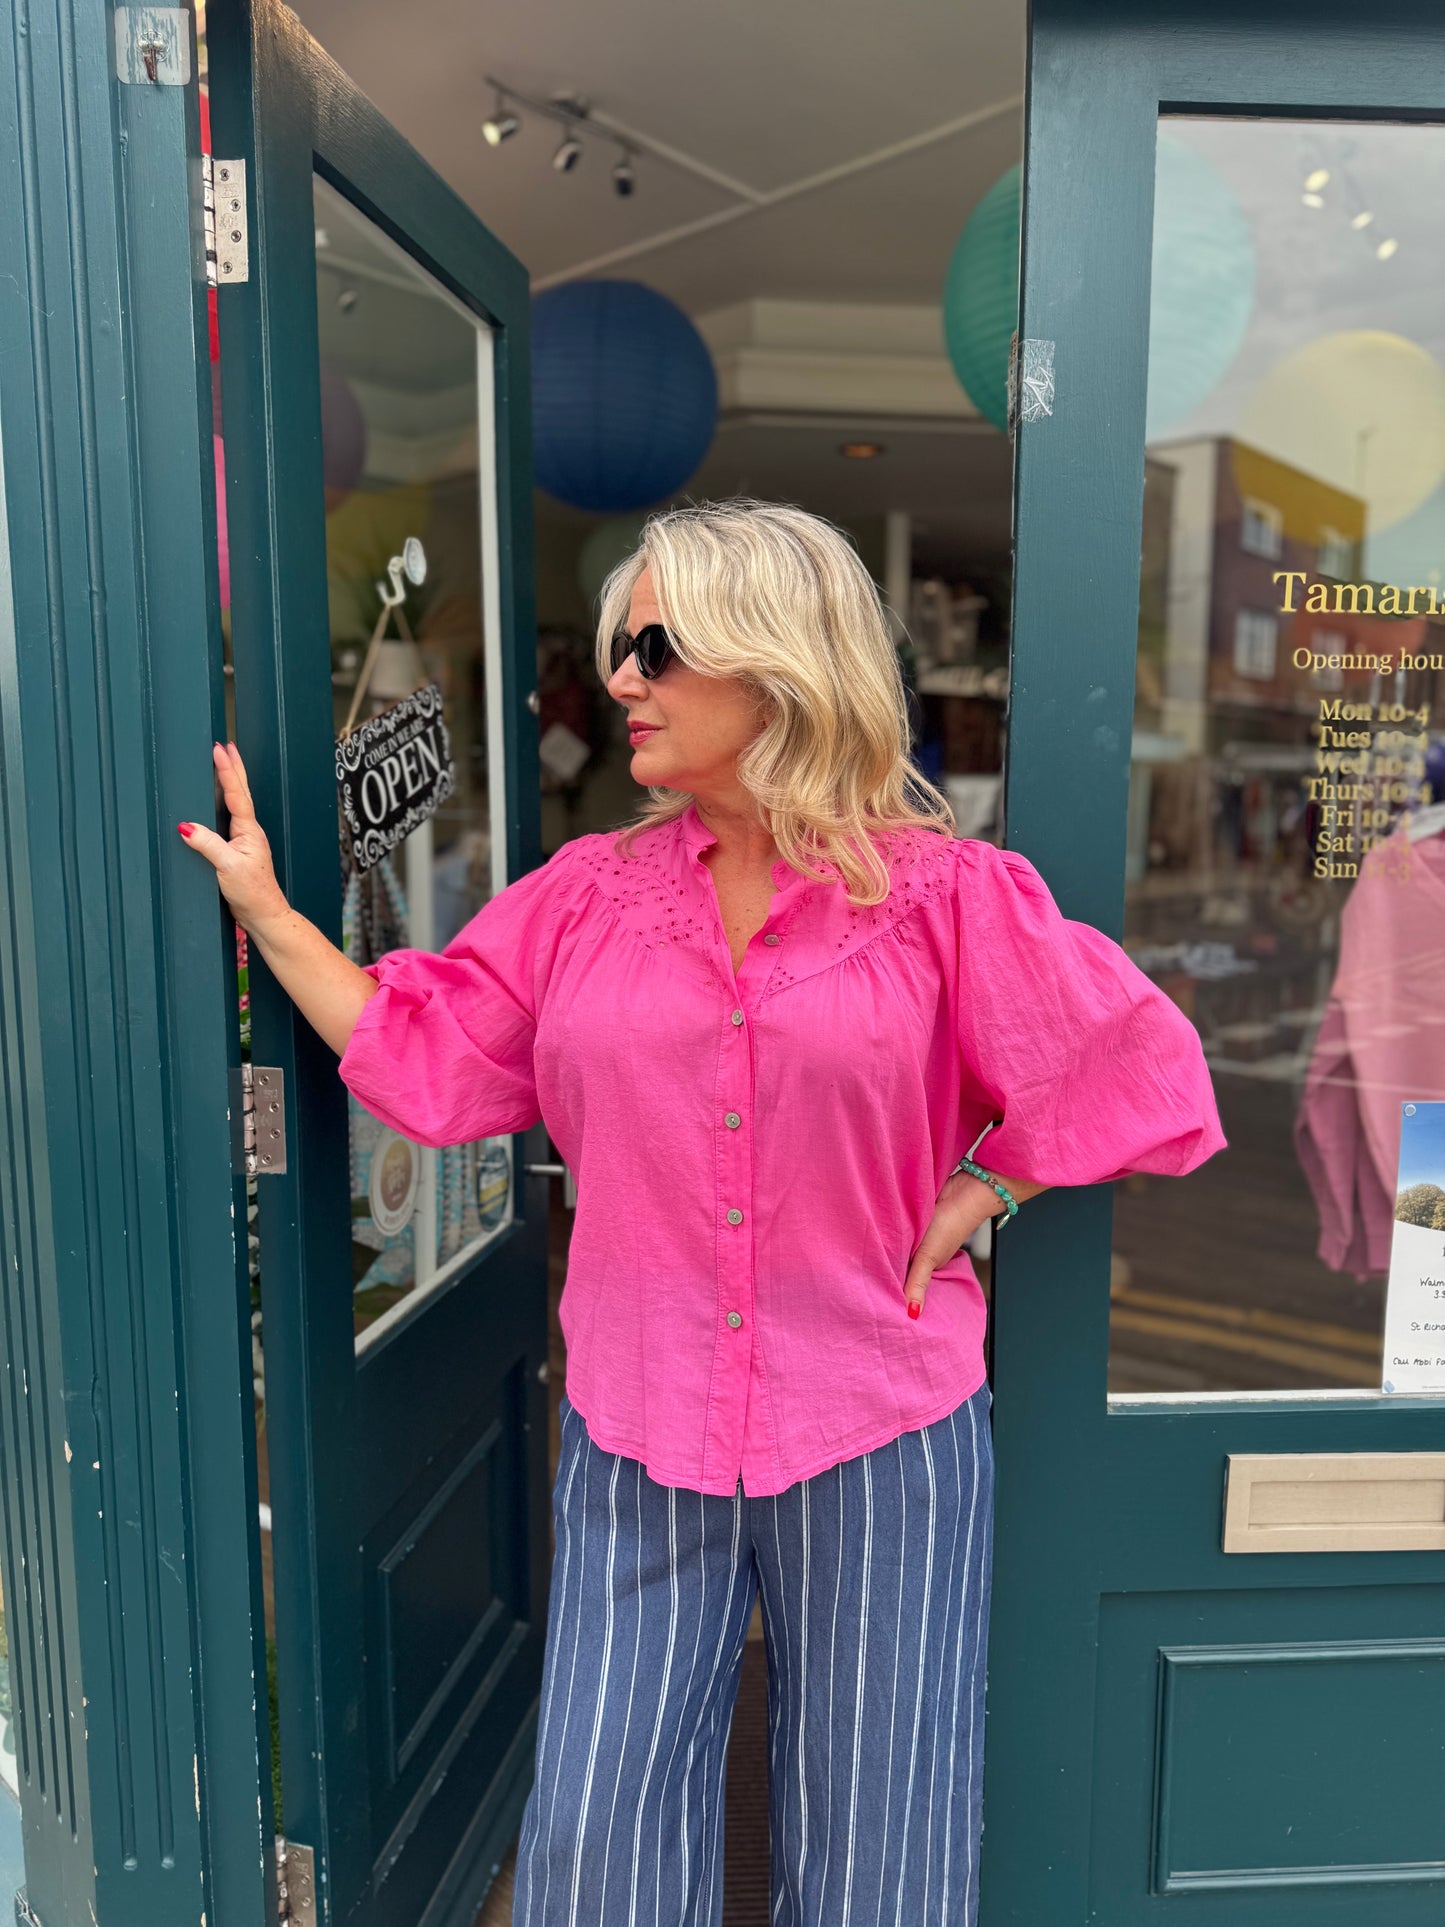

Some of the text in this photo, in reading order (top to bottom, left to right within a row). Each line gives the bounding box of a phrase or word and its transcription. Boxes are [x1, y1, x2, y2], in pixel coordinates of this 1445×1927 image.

[1272, 572, 1445, 615] Tamari
[1293, 648, 1393, 675] Opening
[1319, 699, 1430, 727] Mon 10-4
[364, 741, 389, 769] COME
[387, 735, 398, 753] IN
[396, 726, 410, 745] WE
[1319, 726, 1371, 748] Tues
[361, 725, 441, 824] OPEN
[1314, 751, 1370, 775] Wed
[1309, 777, 1374, 800] Thurs
[1320, 804, 1354, 827] Fri
[1316, 831, 1355, 852] Sat
[1314, 856, 1358, 878] Sun
